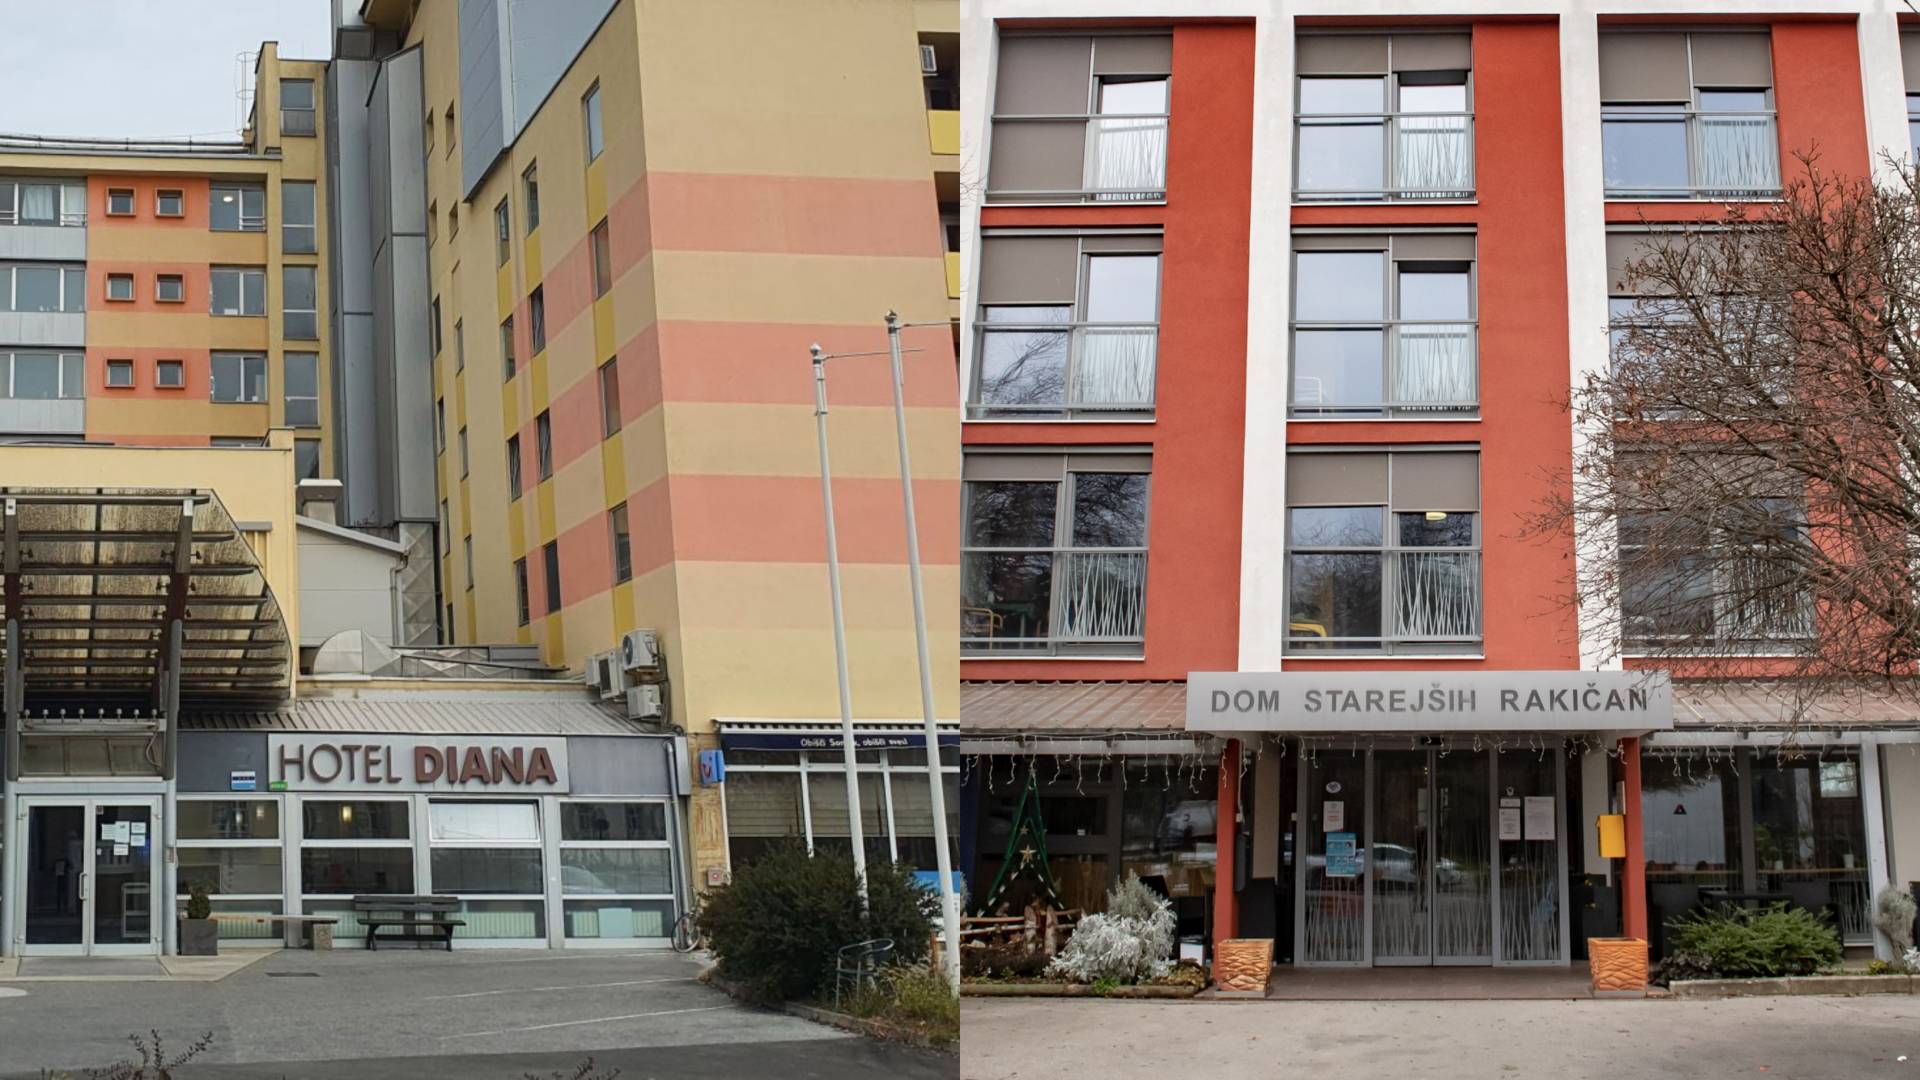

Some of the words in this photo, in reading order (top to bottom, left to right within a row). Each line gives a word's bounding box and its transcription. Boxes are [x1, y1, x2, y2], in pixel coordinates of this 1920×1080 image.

[1211, 690, 1280, 713] DOM
[1304, 683, 1476, 713] STAREJŠIH
[1500, 683, 1647, 712] RAKIČAN
[279, 744, 402, 783] HOTEL
[413, 746, 558, 784] DIANA
